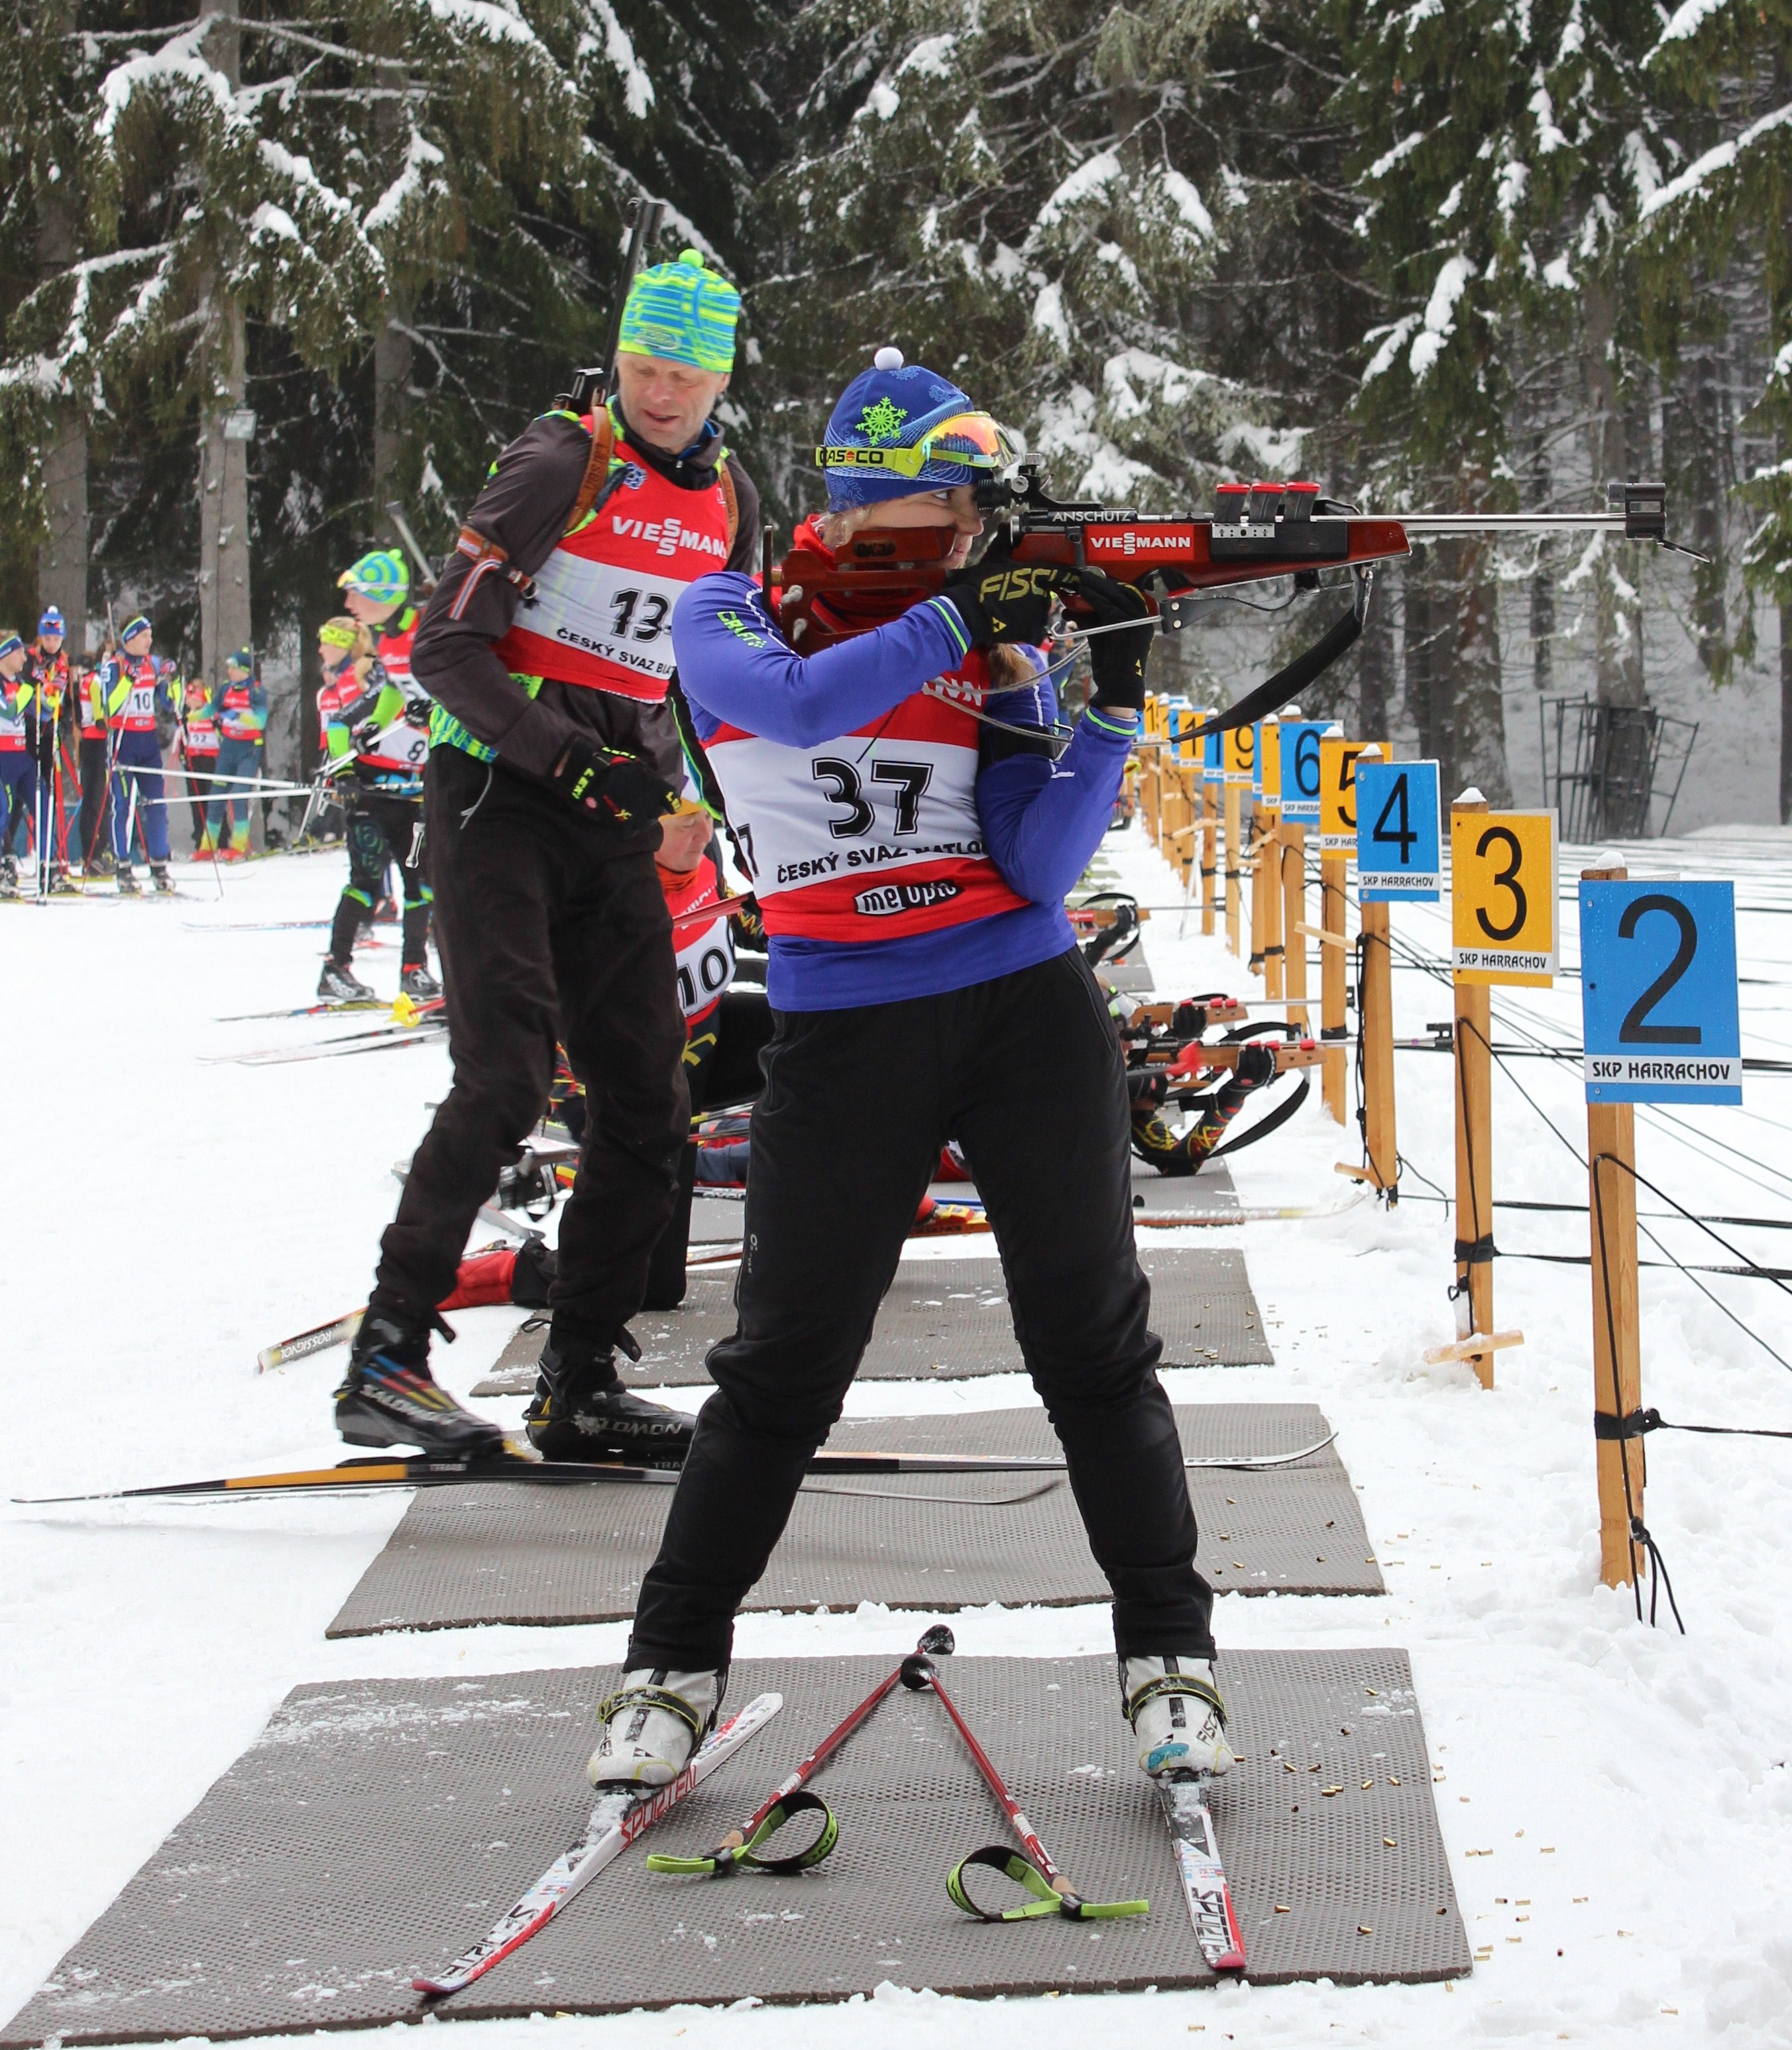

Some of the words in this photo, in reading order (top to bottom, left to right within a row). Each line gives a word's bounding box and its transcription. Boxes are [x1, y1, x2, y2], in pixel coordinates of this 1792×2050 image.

[1052, 511, 1131, 522] ANSCHUTZ
[1090, 532, 1191, 555] VIESSMANN
[557, 627, 614, 656] ČESKÝ
[618, 652, 655, 670] SVAZ
[135, 693, 150, 710] 10
[408, 740, 425, 761] 8
[1235, 724, 1254, 770] 9
[1295, 729, 1320, 797] 6
[812, 757, 934, 839] 37
[1337, 751, 1357, 828] 5
[1372, 773, 1418, 864] 4
[1325, 838, 1338, 846] SKP
[777, 852, 839, 883] ČESKÝ
[1363, 876, 1378, 886] SKP
[1381, 876, 1434, 887] HARRACHOV
[1475, 826, 1528, 942] 3
[677, 946, 729, 1009] 10
[1459, 952, 1478, 966] SKP
[1482, 953, 1547, 970] HARRACHOV
[1618, 894, 1702, 1045] 2
[1593, 1061, 1623, 1078] SKP
[1628, 1062, 1730, 1081] HARRACHOV
[1196, 1711, 1218, 1747] FISC
